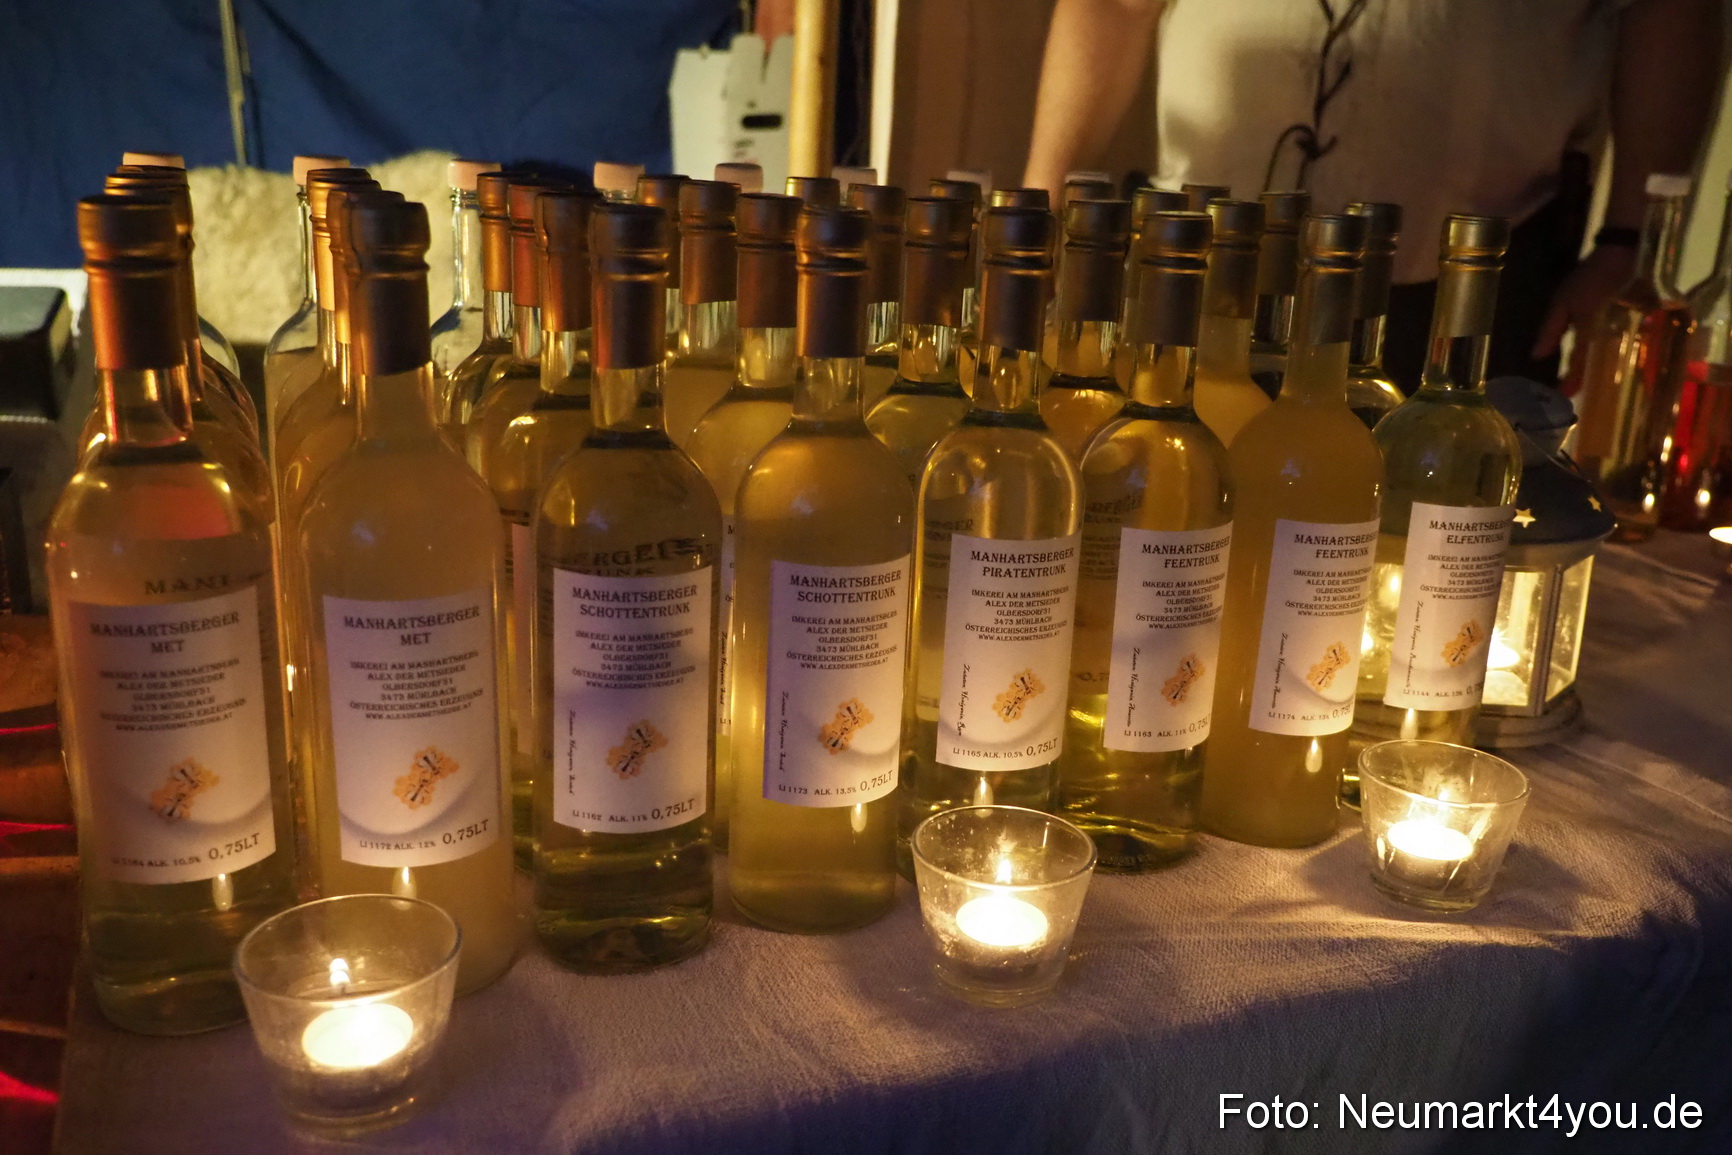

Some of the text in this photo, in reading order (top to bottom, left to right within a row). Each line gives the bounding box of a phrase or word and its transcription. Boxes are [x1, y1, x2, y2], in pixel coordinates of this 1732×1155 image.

[971, 547, 1074, 563] MANHARTSBERGER
[1164, 554, 1219, 568] FEENTRUNK
[1316, 547, 1369, 558] FEENTRUNK
[790, 570, 901, 588] MANHARTSBERGER
[982, 564, 1066, 578] PIRATENTRUNK
[573, 585, 697, 602] MANHARTSBERGER
[797, 586, 896, 603] SCHOTTENTRUNK
[972, 589, 1003, 598] IMKEREI
[344, 606, 480, 629] MANHARTSBERGER
[580, 602, 690, 618] SCHOTTENTRUNK
[151, 640, 184, 653] MET
[401, 633, 431, 645] MET
[1026, 738, 1058, 756] 0,75LT
[788, 786, 808, 794] 1173
[860, 770, 893, 791] 0,75LT
[652, 798, 694, 820] 0,75LT
[443, 819, 489, 844] 0,75LT
[209, 833, 259, 860] 0,75LT
